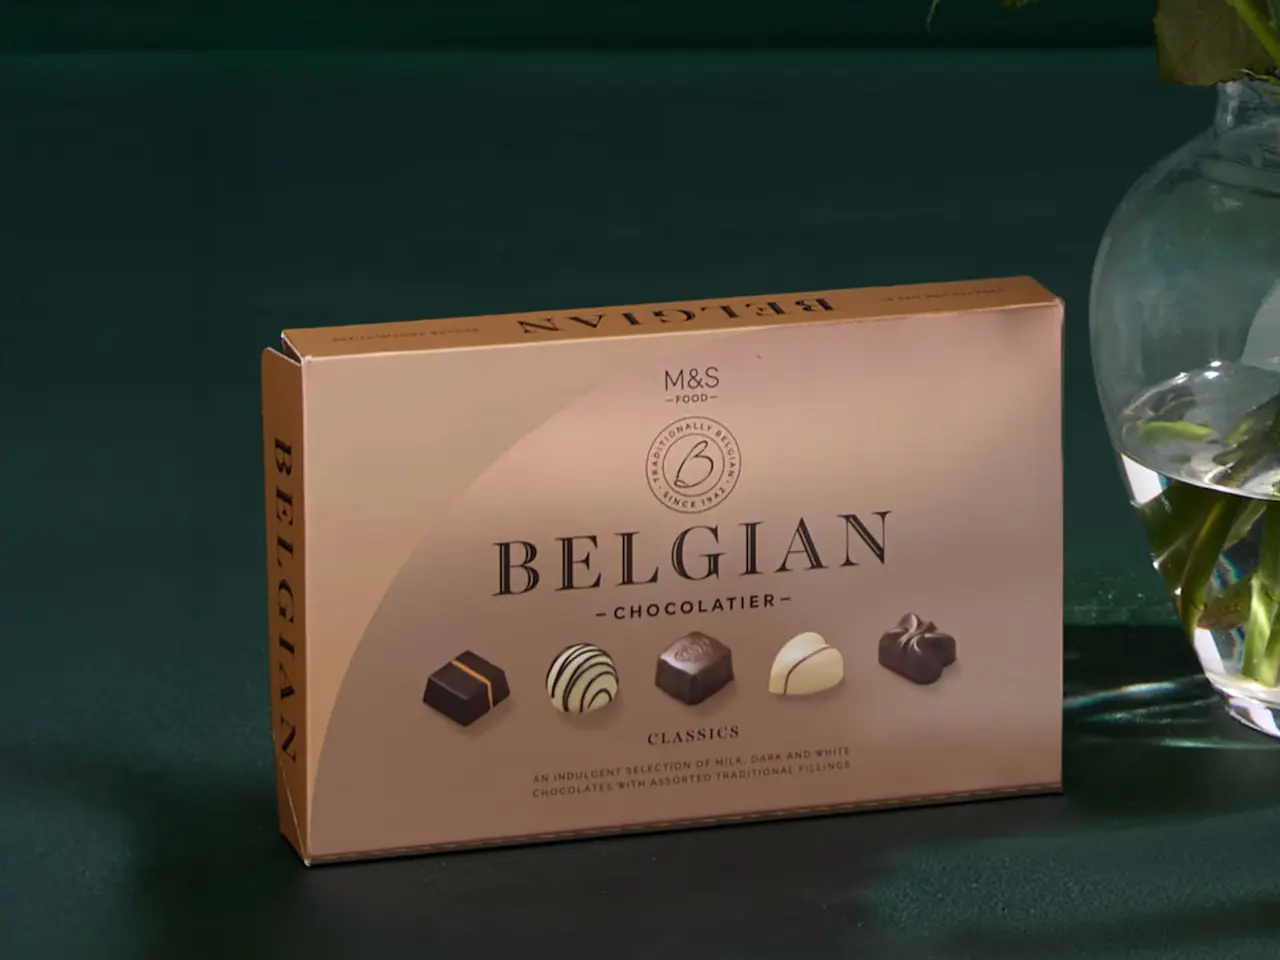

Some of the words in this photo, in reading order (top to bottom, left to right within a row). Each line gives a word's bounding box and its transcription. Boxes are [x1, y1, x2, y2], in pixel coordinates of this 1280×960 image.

[517, 297, 835, 334] BELGIAN
[664, 365, 720, 391] M&S
[651, 422, 712, 484] TRADITIONALLY
[715, 429, 737, 480] BELGIAN
[662, 490, 697, 509] SINCE
[491, 510, 893, 597] BELGIAN
[274, 436, 297, 763] BELGIAN
[646, 724, 740, 746] CLASSICS
[532, 773, 550, 784] AN
[553, 766, 622, 783] INDULGENT
[625, 759, 692, 776] SELECTION
[695, 757, 711, 769] OF
[714, 755, 747, 768] MILK,
[750, 752, 782, 765] DARK
[786, 749, 812, 761] AND
[814, 745, 851, 758] WHITE
[532, 782, 613, 799] CHOCOLATES
[616, 778, 647, 791] WITH
[650, 772, 712, 788] ASSORTED
[715, 764, 794, 783] TRADITIONAL
[798, 759, 851, 774] FILLINGS
